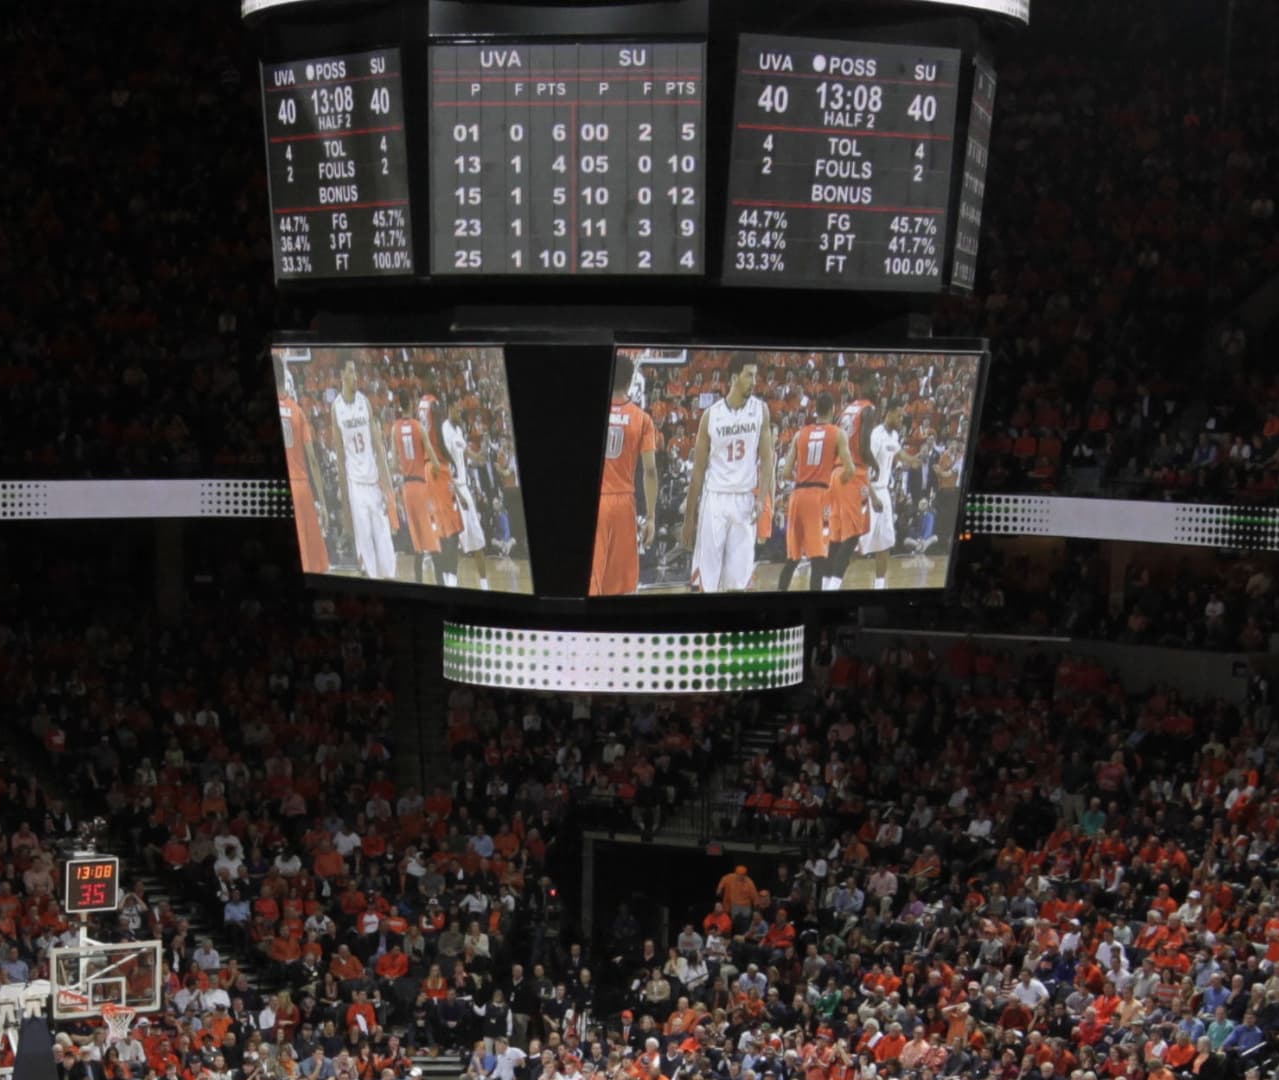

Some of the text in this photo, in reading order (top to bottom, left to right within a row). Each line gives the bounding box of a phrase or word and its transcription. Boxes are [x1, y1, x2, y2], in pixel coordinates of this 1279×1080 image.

[370, 57, 385, 74] SU
[481, 51, 521, 67] UVA
[619, 50, 645, 66] SU
[760, 54, 792, 71] UVA
[316, 61, 346, 80] POSS
[830, 57, 876, 77] POSS
[915, 65, 935, 81] SU
[275, 69, 295, 86] UVA
[472, 84, 480, 96] P
[515, 83, 522, 96] F
[537, 83, 566, 95] PTS
[600, 83, 608, 94] P
[644, 82, 651, 94] F
[666, 82, 695, 94] PTS
[311, 86, 353, 115] 13:08
[371, 88, 389, 114] 40
[758, 85, 788, 112] 40
[817, 82, 882, 112] 13:08
[278, 99, 296, 124] 40
[908, 95, 936, 121] 40
[319, 114, 351, 130] HALF 2
[824, 111, 874, 128] HALF 2
[454, 124, 478, 141] 01
[510, 124, 523, 141] 0
[553, 124, 566, 141] 6
[581, 124, 608, 141] 00
[639, 124, 651, 141] 2
[682, 123, 695, 140] 5
[324, 140, 346, 157] TOL
[380, 136, 387, 152] 4
[764, 135, 773, 151] 4
[829, 138, 861, 156] TOL
[915, 143, 924, 159] 4
[286, 145, 292, 160] 4
[319, 160, 355, 179] FOULS
[382, 158, 388, 174] 2
[455, 156, 480, 173] 13
[511, 156, 521, 173] 1
[552, 156, 566, 173] 4
[581, 156, 608, 173] 05
[638, 156, 651, 173] 0
[668, 155, 694, 172] 10
[762, 157, 772, 174] 2
[816, 159, 872, 179] FOULS
[287, 166, 293, 182] 2
[914, 165, 923, 181] 2
[319, 185, 358, 203] BONUS
[456, 187, 481, 204] 15
[512, 187, 521, 204] 1
[553, 188, 565, 204] 5
[582, 187, 608, 204] 10
[638, 188, 651, 204] 0
[668, 187, 694, 204] 12
[812, 184, 871, 204] BONUS
[280, 216, 309, 232] 44.7%
[332, 213, 347, 229] FG
[373, 210, 404, 227] 45.7%
[739, 210, 787, 228] 44.7%
[828, 213, 850, 231] FG
[890, 217, 936, 234] 45.7%
[455, 219, 481, 236] 23
[512, 219, 521, 236] 1
[554, 219, 566, 236] 3
[582, 219, 606, 236] 11
[639, 219, 651, 236] 3
[681, 219, 694, 236] 9
[281, 236, 310, 252] 36.4%
[330, 232, 352, 250] 3 PT
[374, 230, 406, 247] 41.7%
[738, 230, 785, 249] 36.4%
[820, 233, 855, 251] 3 PT
[889, 236, 935, 254] 41.7%
[282, 256, 311, 272] 33.3%
[336, 254, 349, 270] FT
[373, 251, 410, 268] 100.0%
[455, 251, 481, 267] 25
[512, 250, 521, 267] 1
[540, 250, 566, 267] 10
[582, 251, 608, 268] 25
[638, 251, 650, 268] 2
[680, 251, 694, 267] 4
[736, 252, 784, 271] 33.3%
[826, 255, 846, 272] FT
[885, 258, 938, 275] 100.0%
[716, 422, 756, 436] VIRGINIA
[726, 439, 745, 462] 13
[76, 865, 112, 880] 13:08
[78, 884, 106, 906] 35
